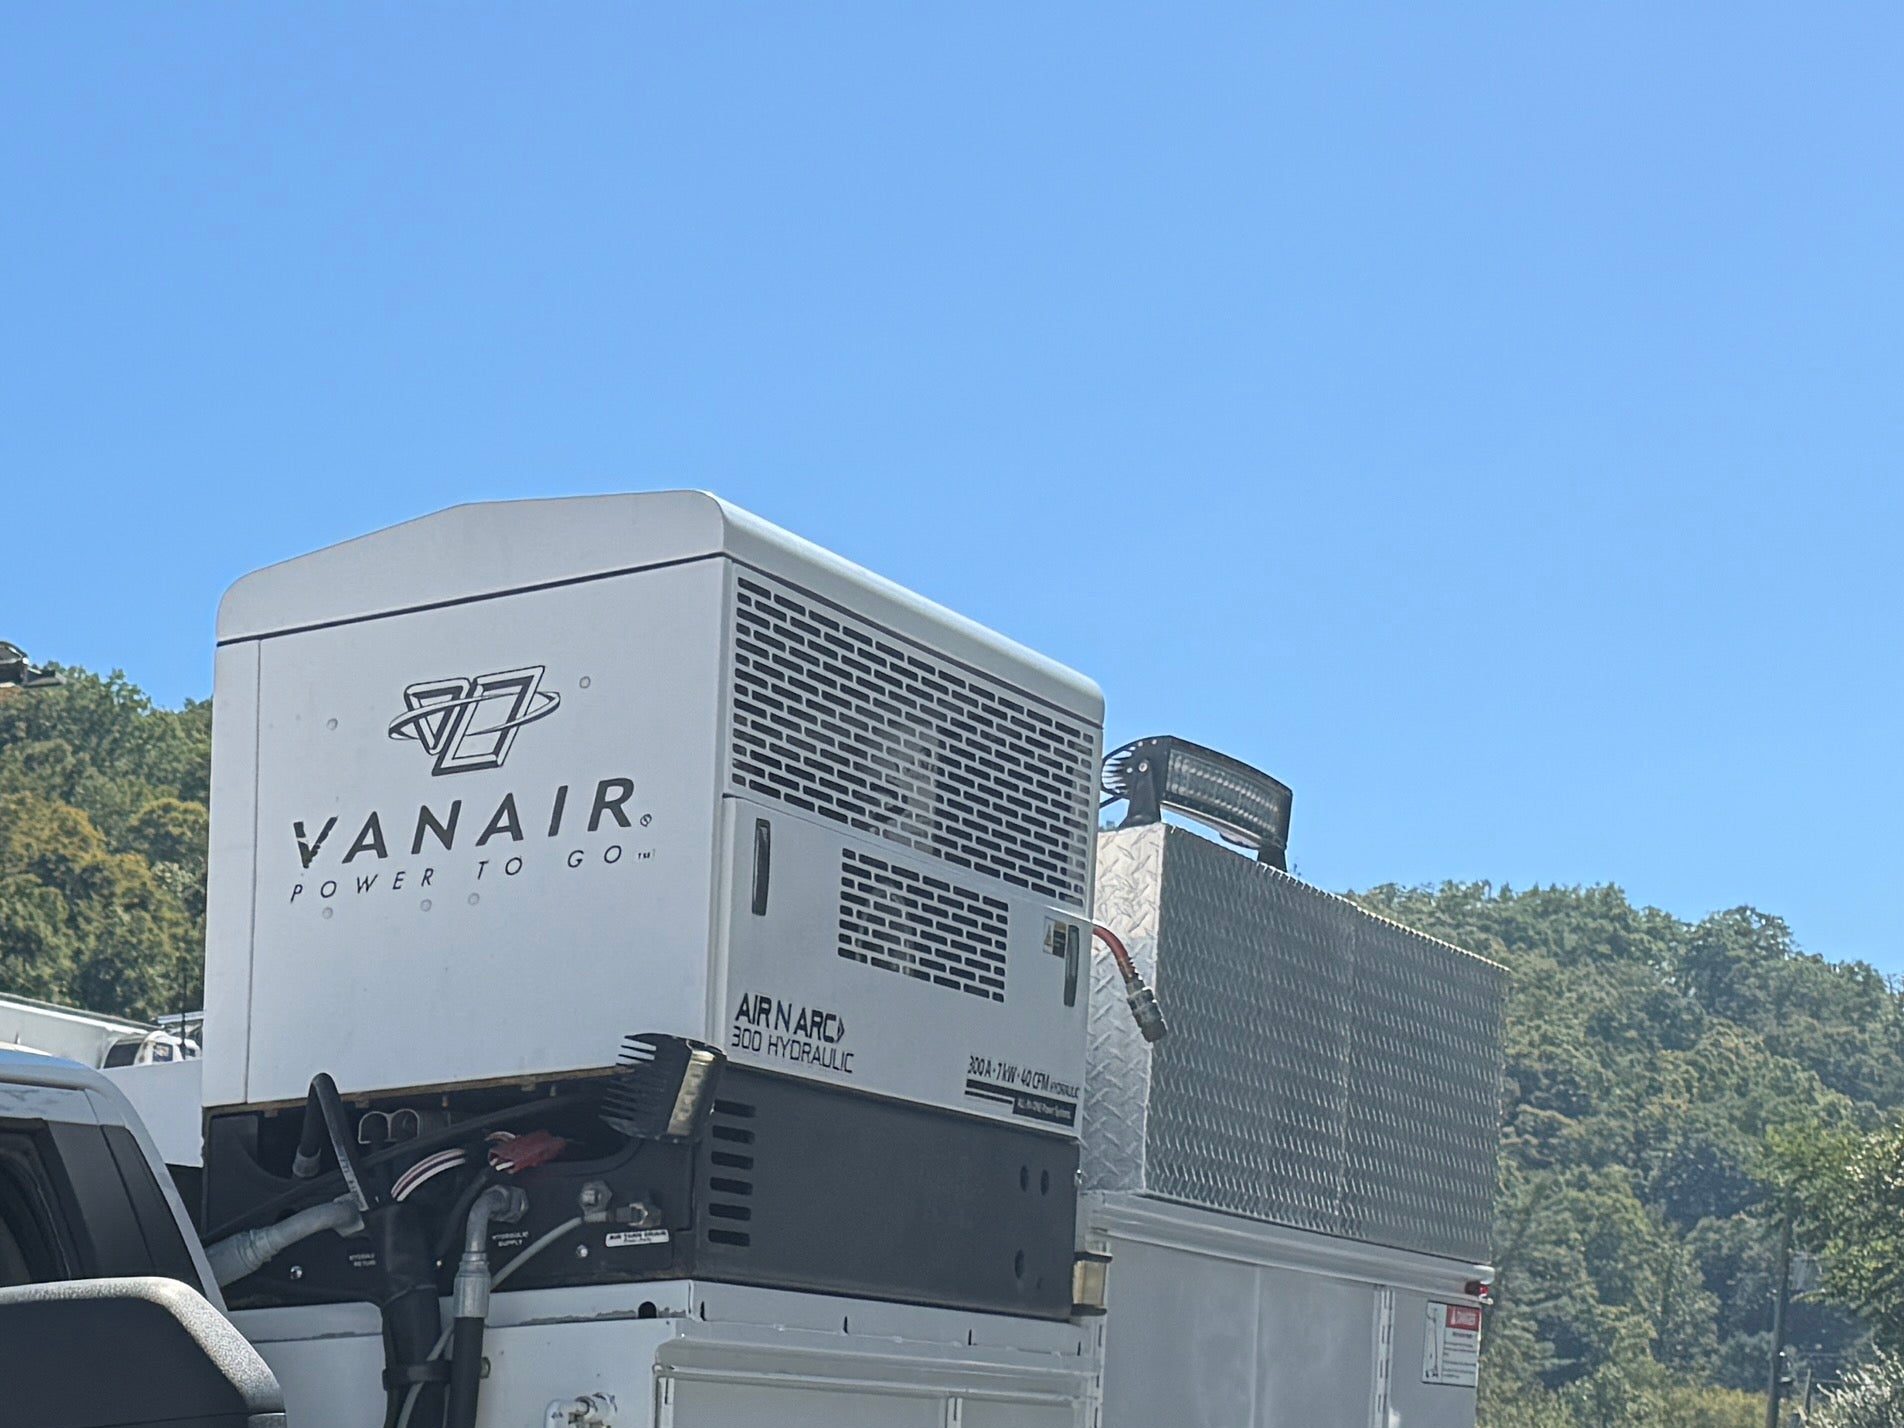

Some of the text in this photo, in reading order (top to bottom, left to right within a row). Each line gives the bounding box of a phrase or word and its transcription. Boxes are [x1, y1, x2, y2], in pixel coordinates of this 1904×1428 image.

[291, 845, 622, 903] POWER TO GO
[735, 992, 838, 1043] AIR N ARC
[732, 1025, 855, 1074] 300 HYDRAULIC
